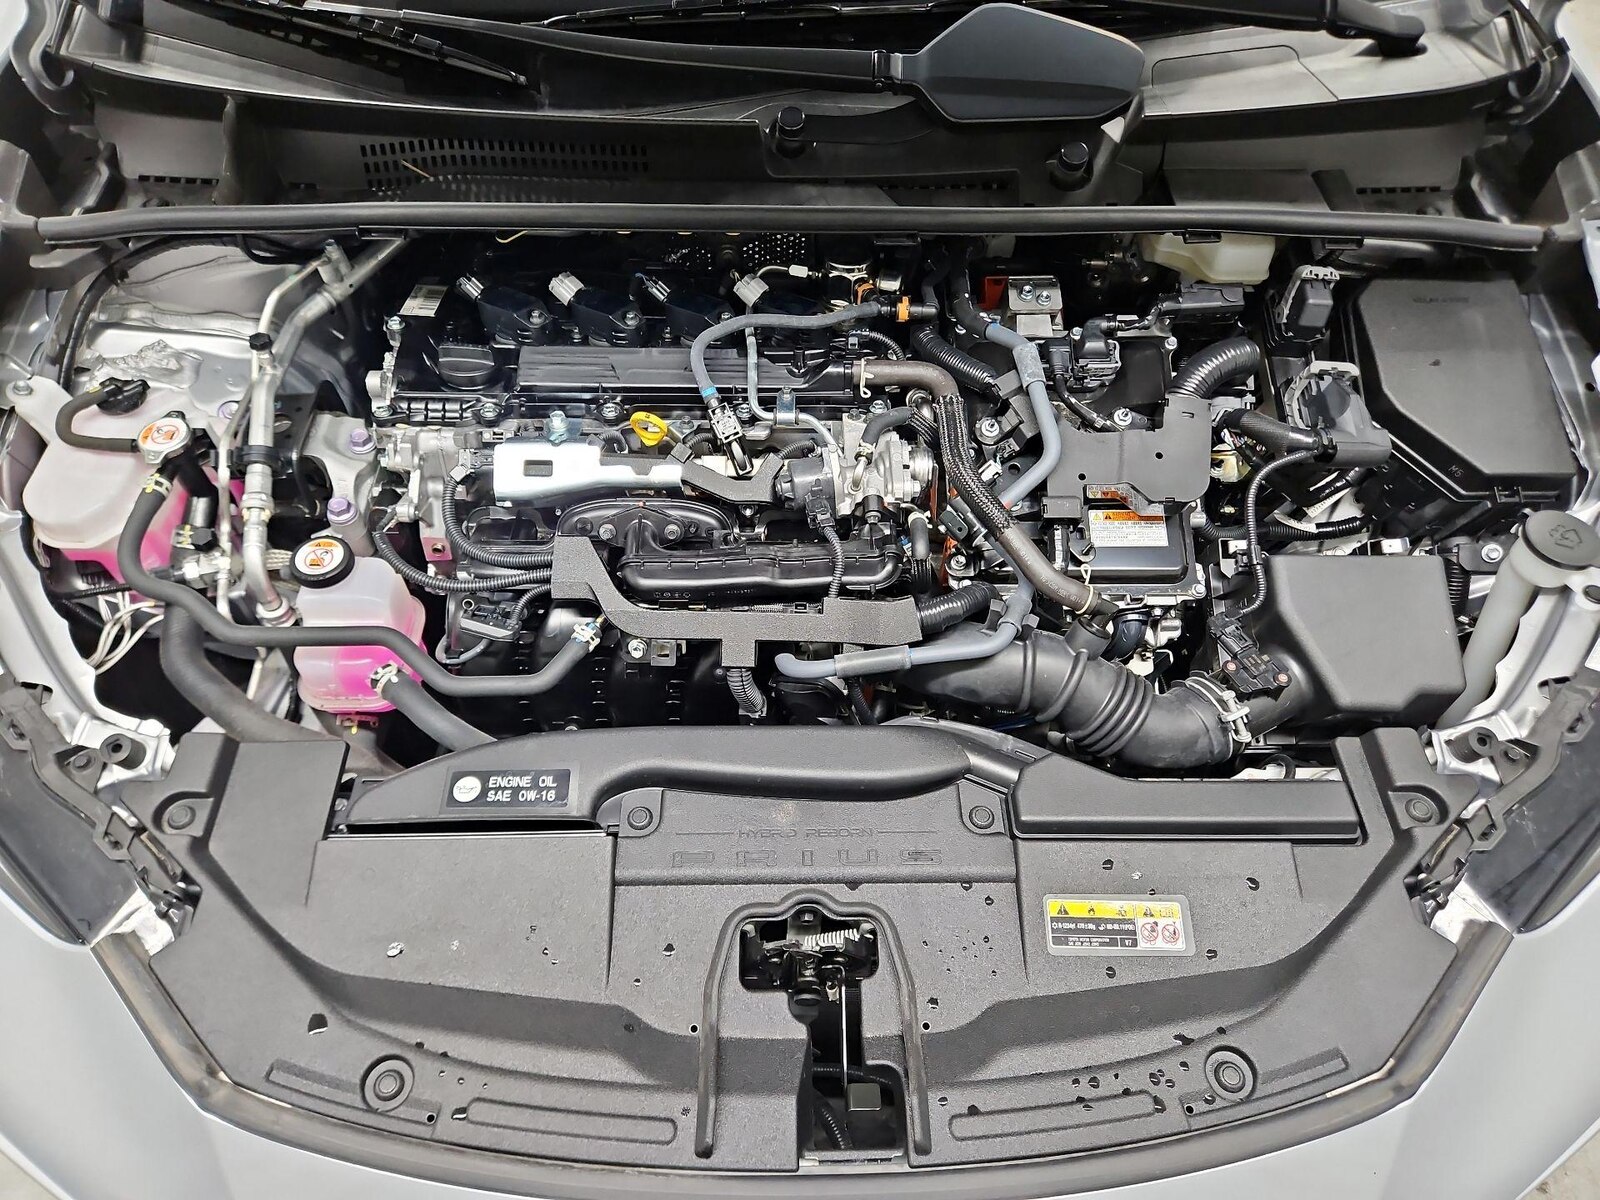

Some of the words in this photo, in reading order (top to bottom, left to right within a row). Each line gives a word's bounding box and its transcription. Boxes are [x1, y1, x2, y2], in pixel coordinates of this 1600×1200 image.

[488, 775, 532, 788] ENGINE
[538, 775, 558, 788] OIL
[486, 789, 512, 802] SAE
[518, 789, 556, 802] 0W-16
[738, 828, 797, 839] HYBRD
[805, 827, 874, 838] REBORN
[671, 849, 942, 868] PRIUS
